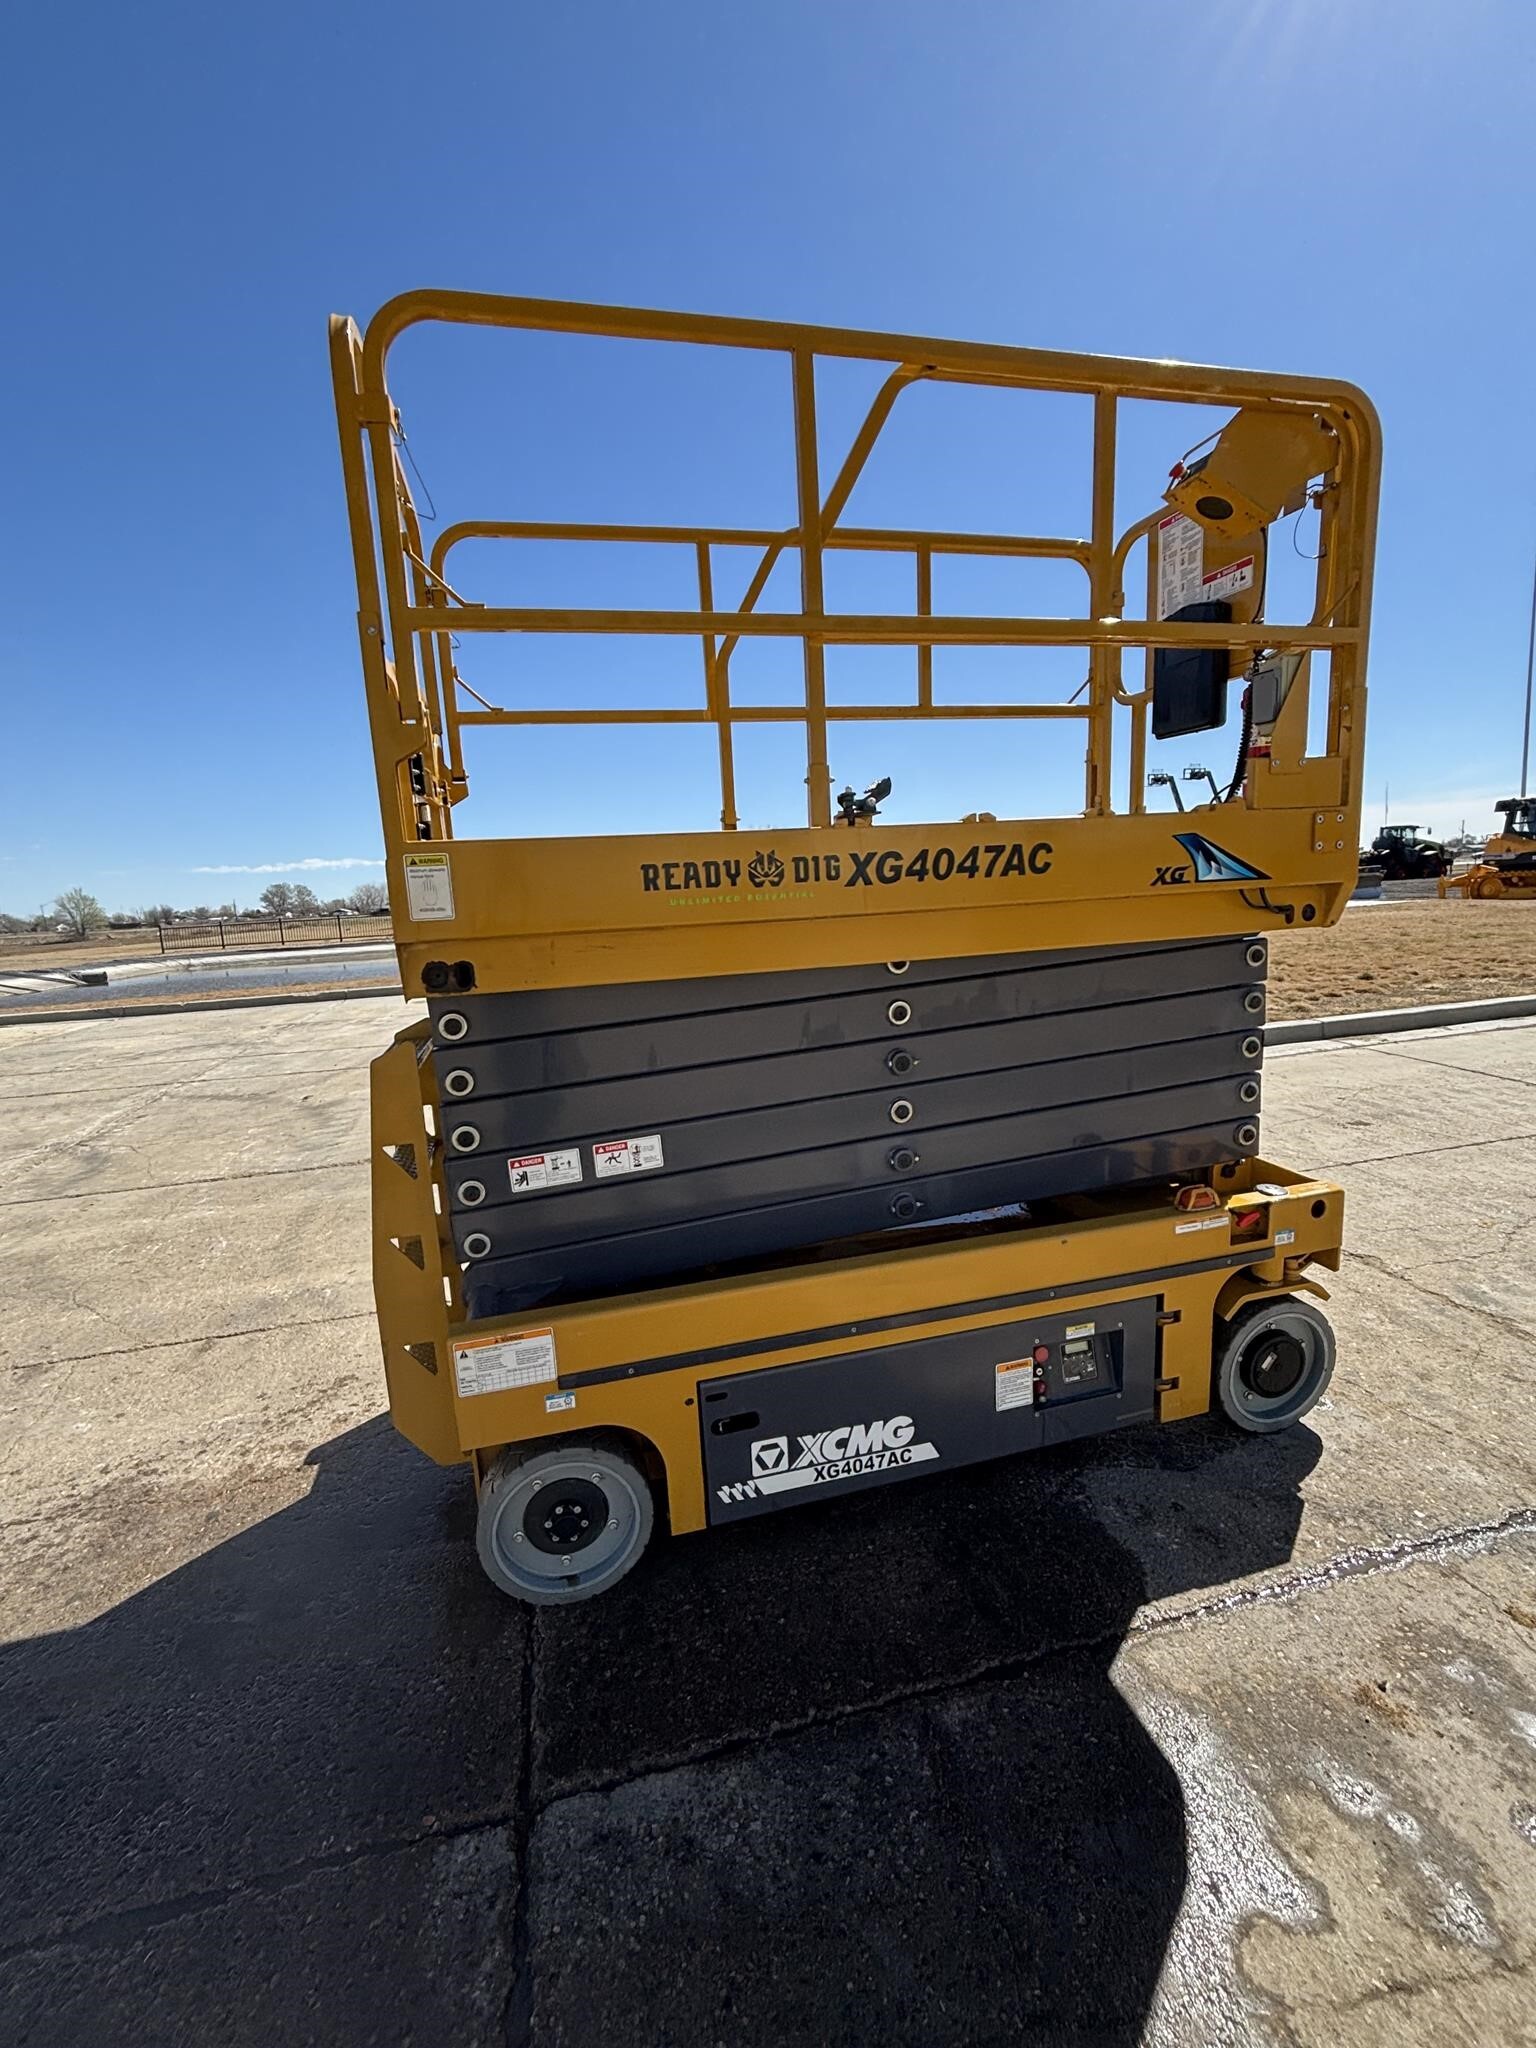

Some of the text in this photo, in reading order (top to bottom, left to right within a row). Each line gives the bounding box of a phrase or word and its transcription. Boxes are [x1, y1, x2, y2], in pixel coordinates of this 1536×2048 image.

[640, 854, 841, 892] READY DIG
[844, 842, 1054, 887] XG4047AC
[1150, 864, 1192, 886] XG
[521, 1157, 542, 1166] DANGER
[790, 1415, 915, 1470] XCMG
[813, 1448, 912, 1482] XG4047AC
